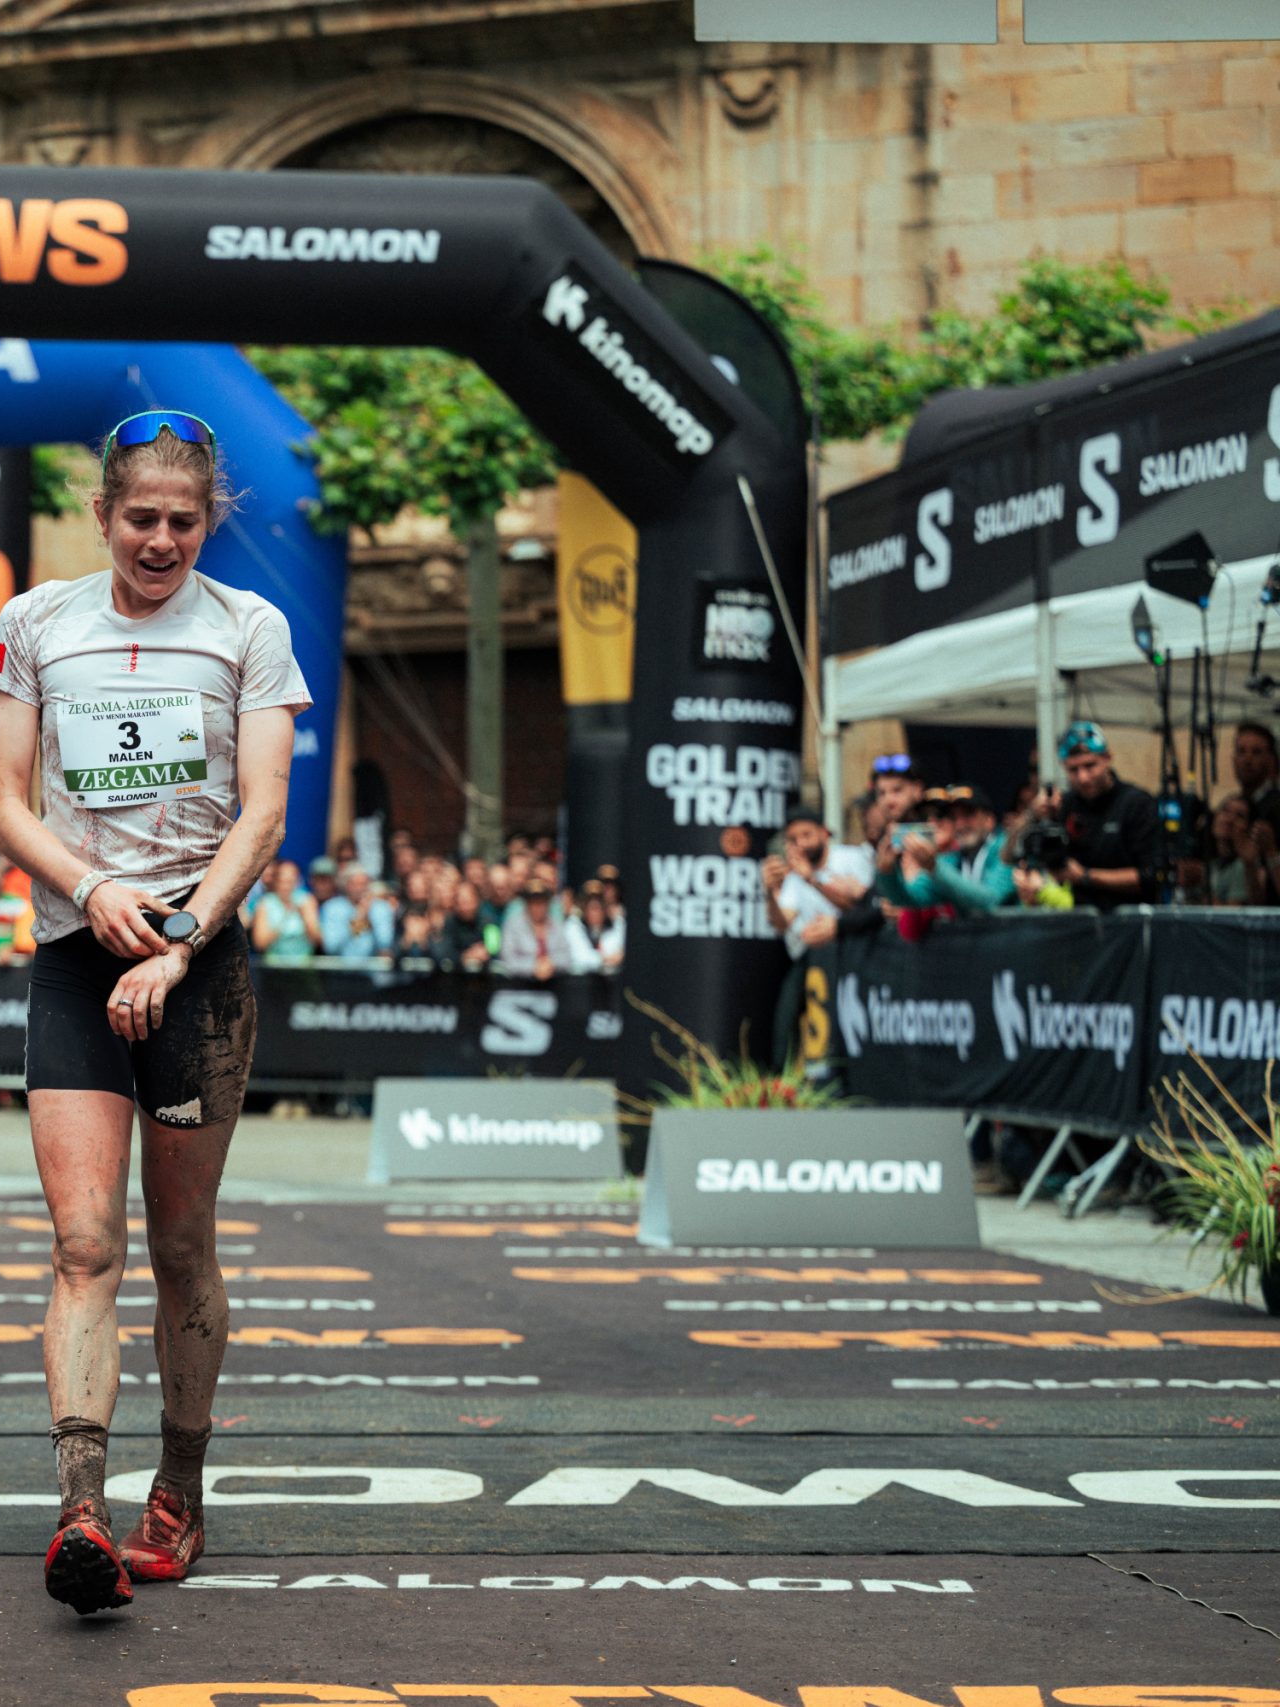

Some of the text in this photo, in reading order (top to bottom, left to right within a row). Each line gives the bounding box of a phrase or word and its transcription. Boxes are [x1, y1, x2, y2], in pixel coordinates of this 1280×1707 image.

[205, 225, 441, 263] SALOMON
[579, 316, 714, 455] kinomap
[829, 535, 906, 588] SALOMON
[974, 485, 1064, 543] SALOMON
[1077, 432, 1120, 547] S
[1139, 432, 1247, 497] SALOMON
[106, 712, 126, 720] MENDI
[118, 721, 142, 750] 3
[109, 751, 153, 763] MALEN
[77, 763, 192, 790] ZEGAMA
[107, 792, 158, 803] SALOMON
[649, 854, 766, 897] WOR
[288, 1001, 459, 1034] SALOMON
[480, 989, 558, 1057] S
[1159, 993, 1280, 1061] SALOM
[448, 1112, 603, 1152] kinomap
[695, 1157, 943, 1194] SALOMON
[891, 1377, 1280, 1391] SALOM
[178, 1573, 976, 1593] SALOMON
